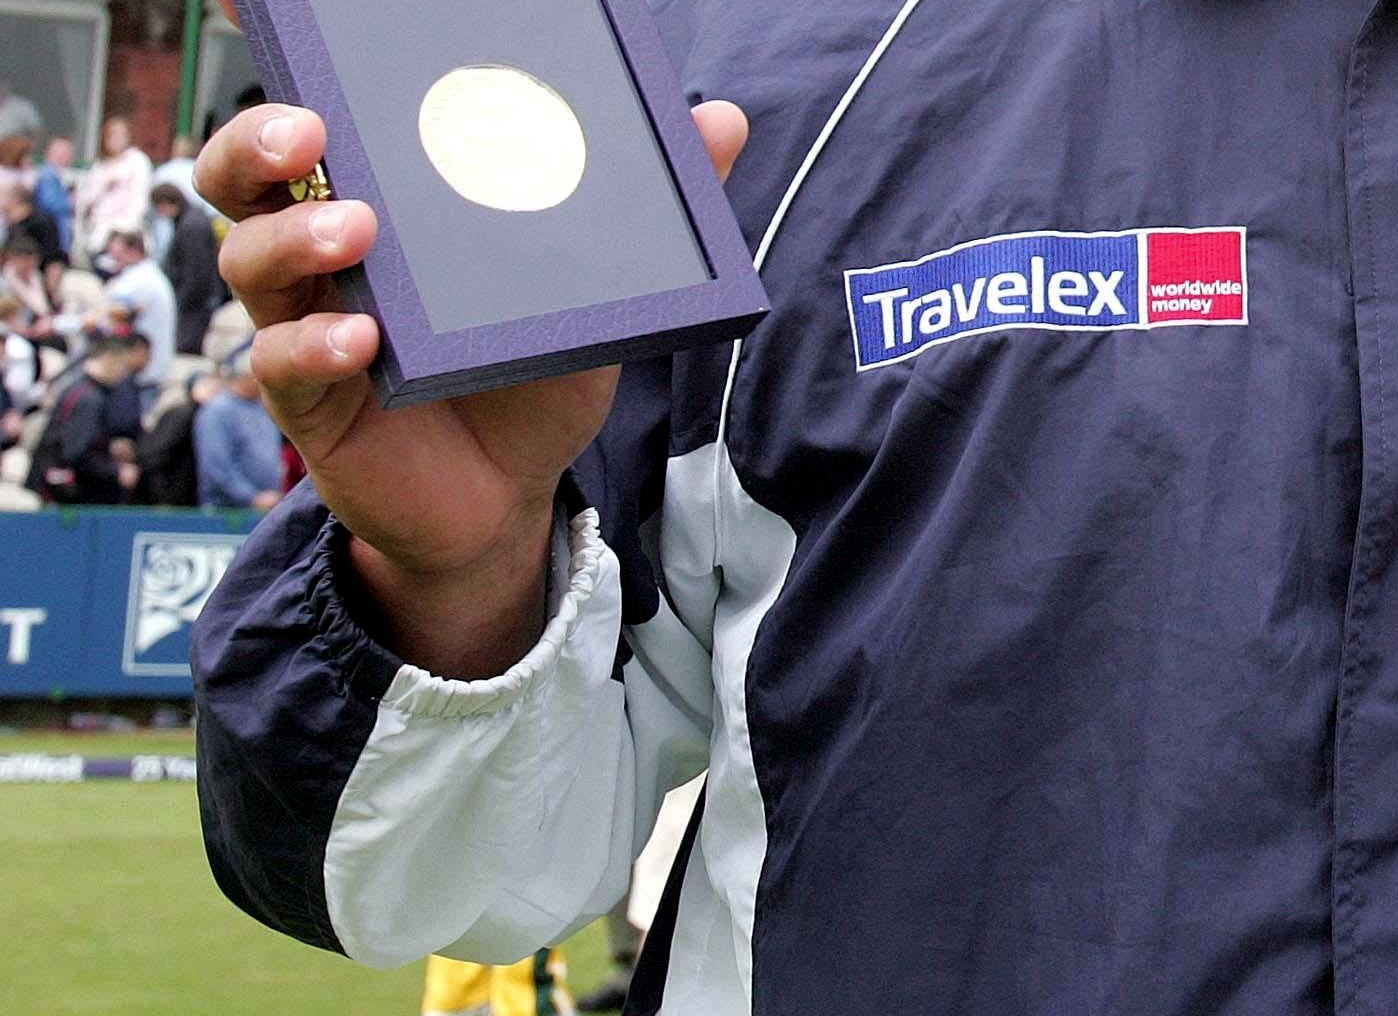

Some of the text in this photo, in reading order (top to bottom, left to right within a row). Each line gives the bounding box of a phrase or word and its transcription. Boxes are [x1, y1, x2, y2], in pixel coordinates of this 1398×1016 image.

[1151, 280, 1242, 297] worldwide
[862, 256, 1128, 349] Travelex
[1151, 297, 1213, 314] money
